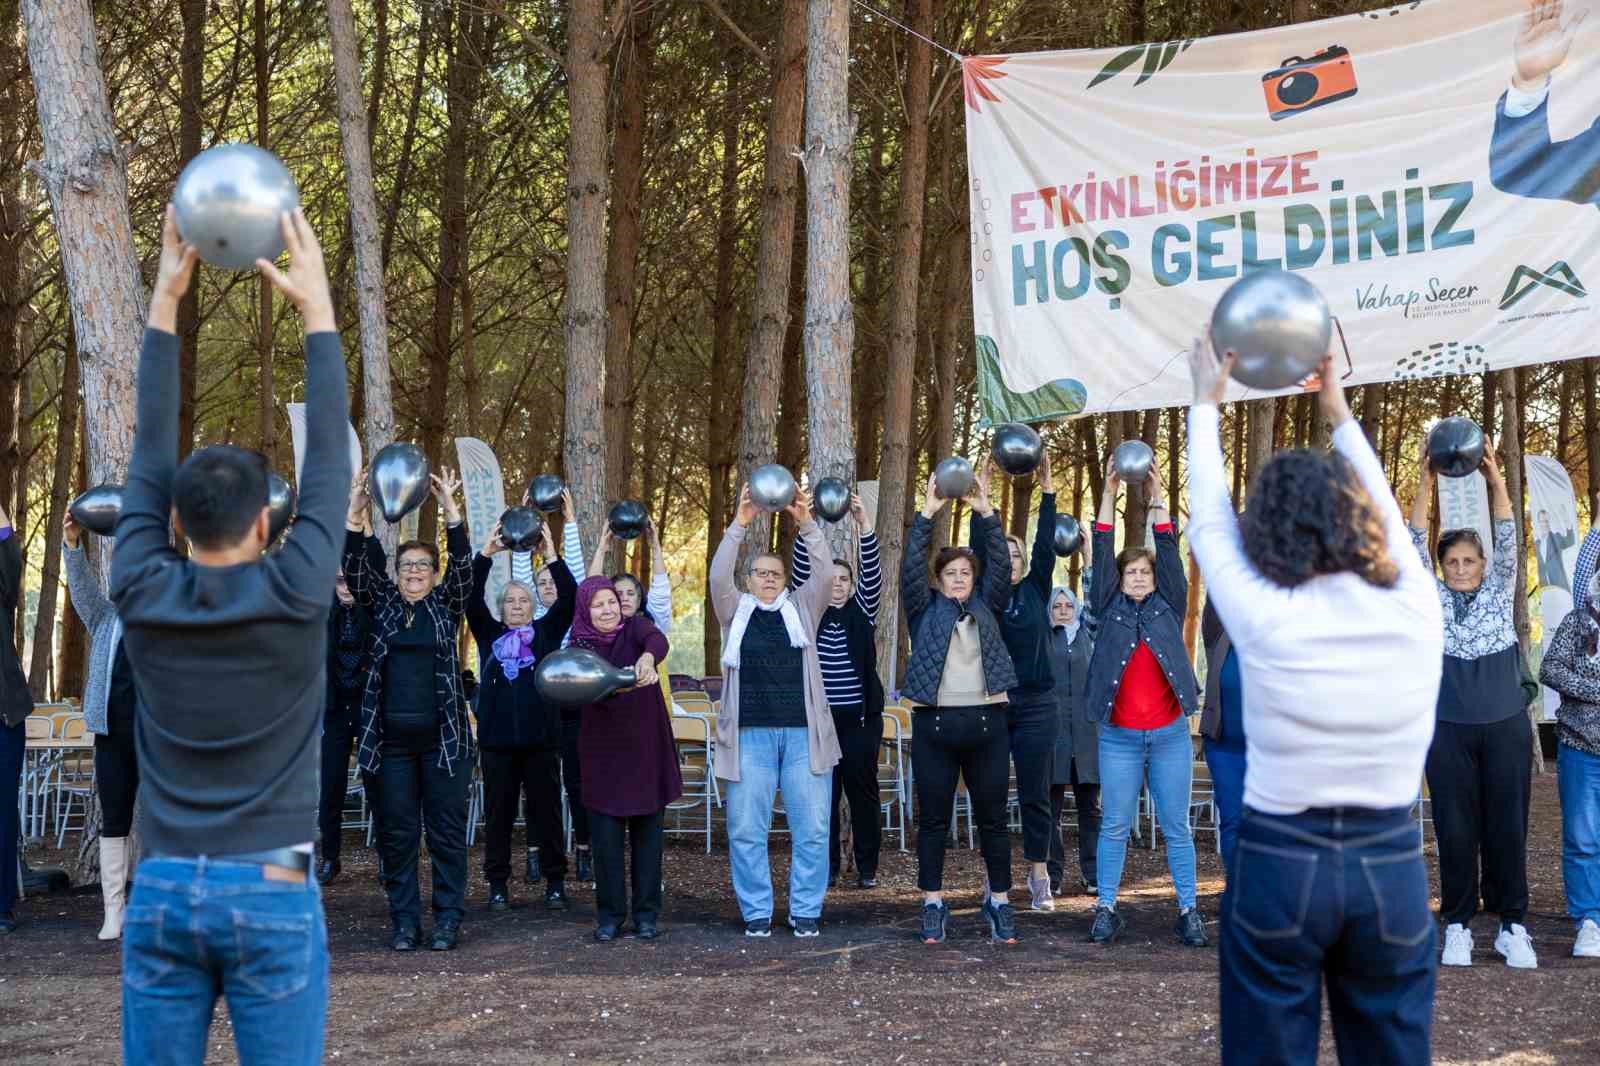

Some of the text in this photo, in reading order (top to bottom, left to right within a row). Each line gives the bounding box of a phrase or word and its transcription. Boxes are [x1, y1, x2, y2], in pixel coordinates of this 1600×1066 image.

[1010, 148, 1319, 234] ETKİNLİĞİMİZE
[1011, 168, 1475, 310] HOŞ GELDİNİZ
[1355, 282, 1420, 319] Vahap
